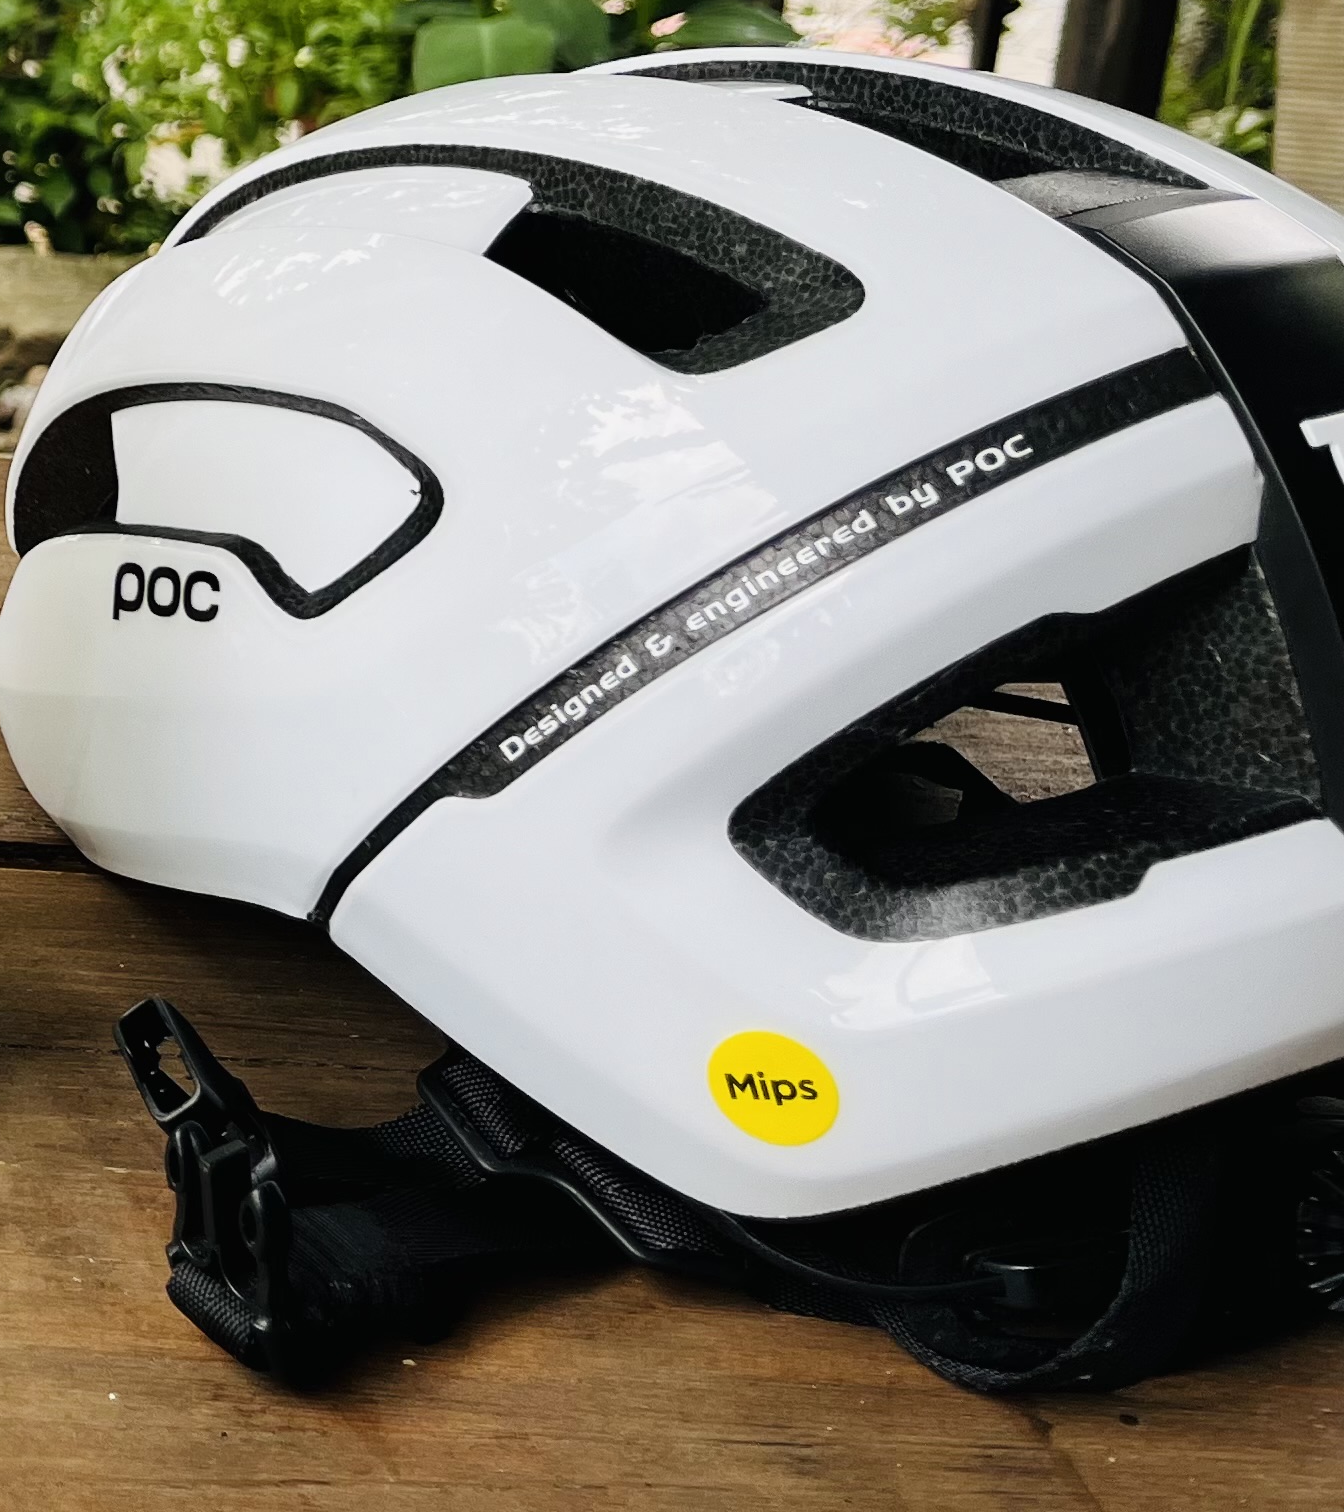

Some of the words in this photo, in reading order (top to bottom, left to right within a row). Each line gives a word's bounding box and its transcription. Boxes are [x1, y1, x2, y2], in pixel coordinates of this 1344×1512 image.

[498, 655, 640, 761] Designed
[644, 632, 674, 658] &
[686, 510, 878, 631] engineered
[885, 482, 940, 516] by
[946, 434, 1033, 486] POC
[724, 1071, 818, 1106] Mips
